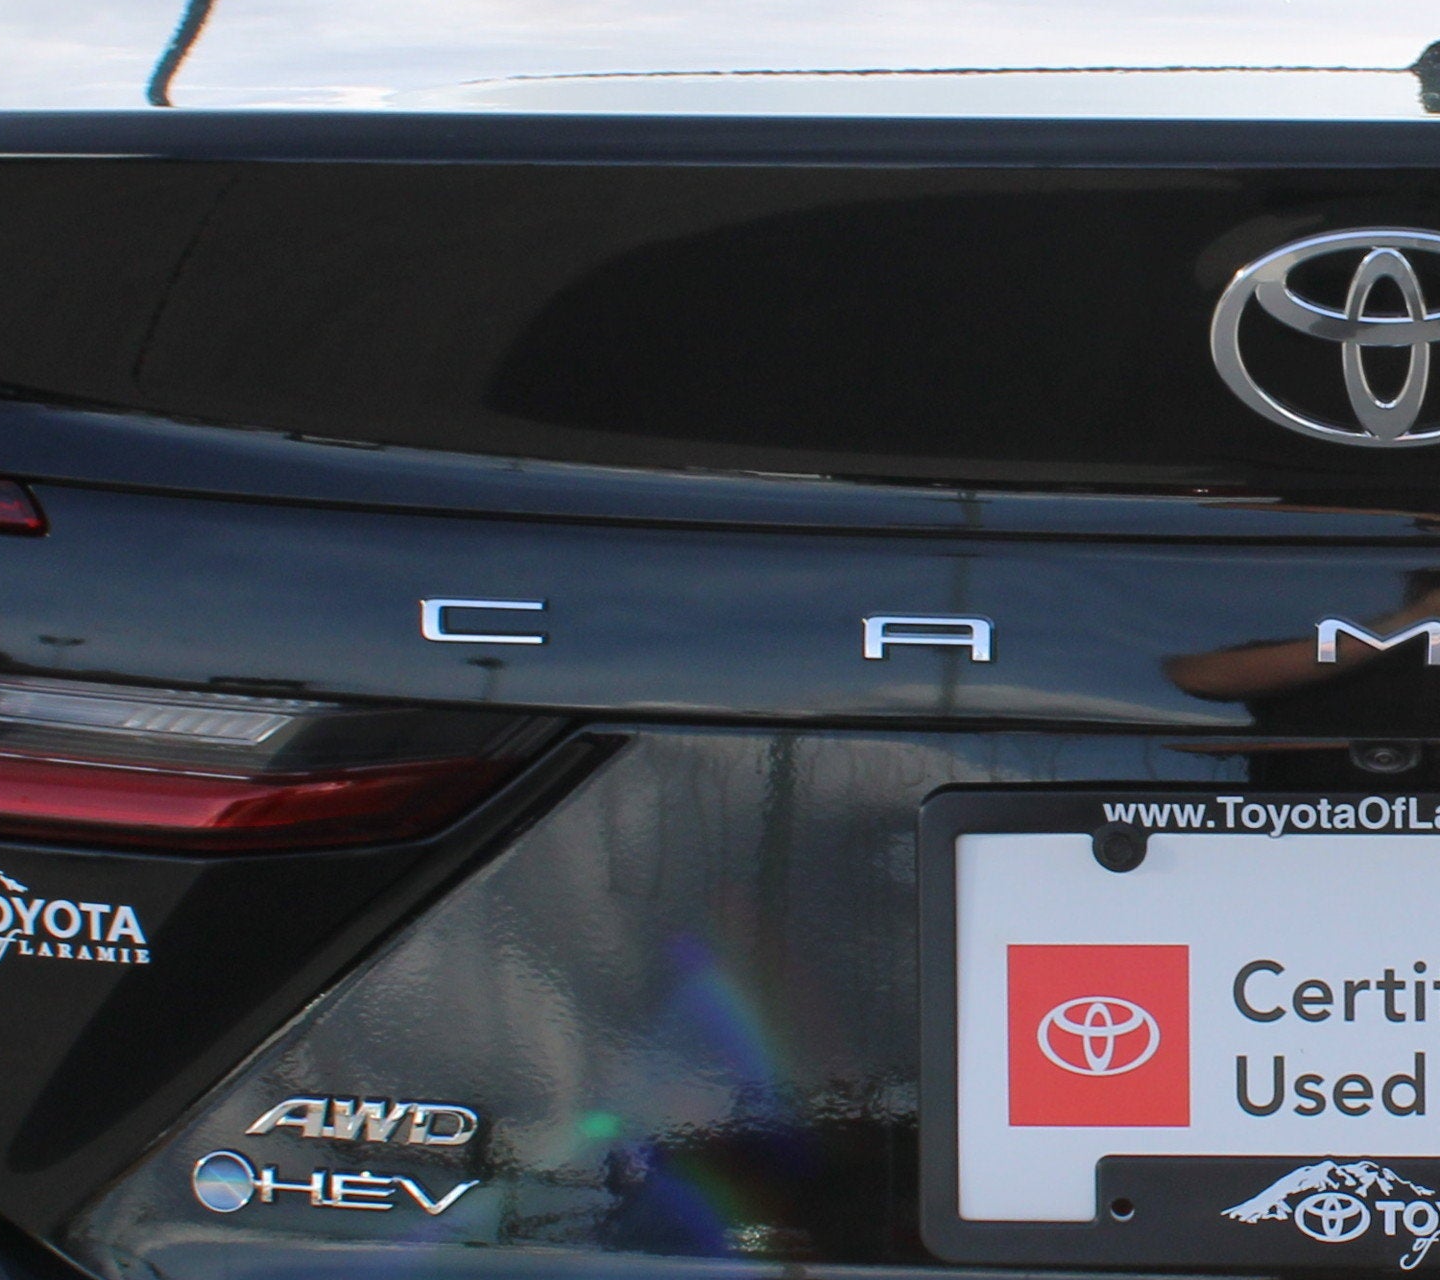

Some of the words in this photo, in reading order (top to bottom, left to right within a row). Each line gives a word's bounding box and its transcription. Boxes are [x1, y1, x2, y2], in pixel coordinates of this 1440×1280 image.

[19, 939, 151, 964] LARAMIE
[1235, 1052, 1427, 1118] Used
[245, 1096, 480, 1146] AWD
[253, 1167, 481, 1216] HEV
